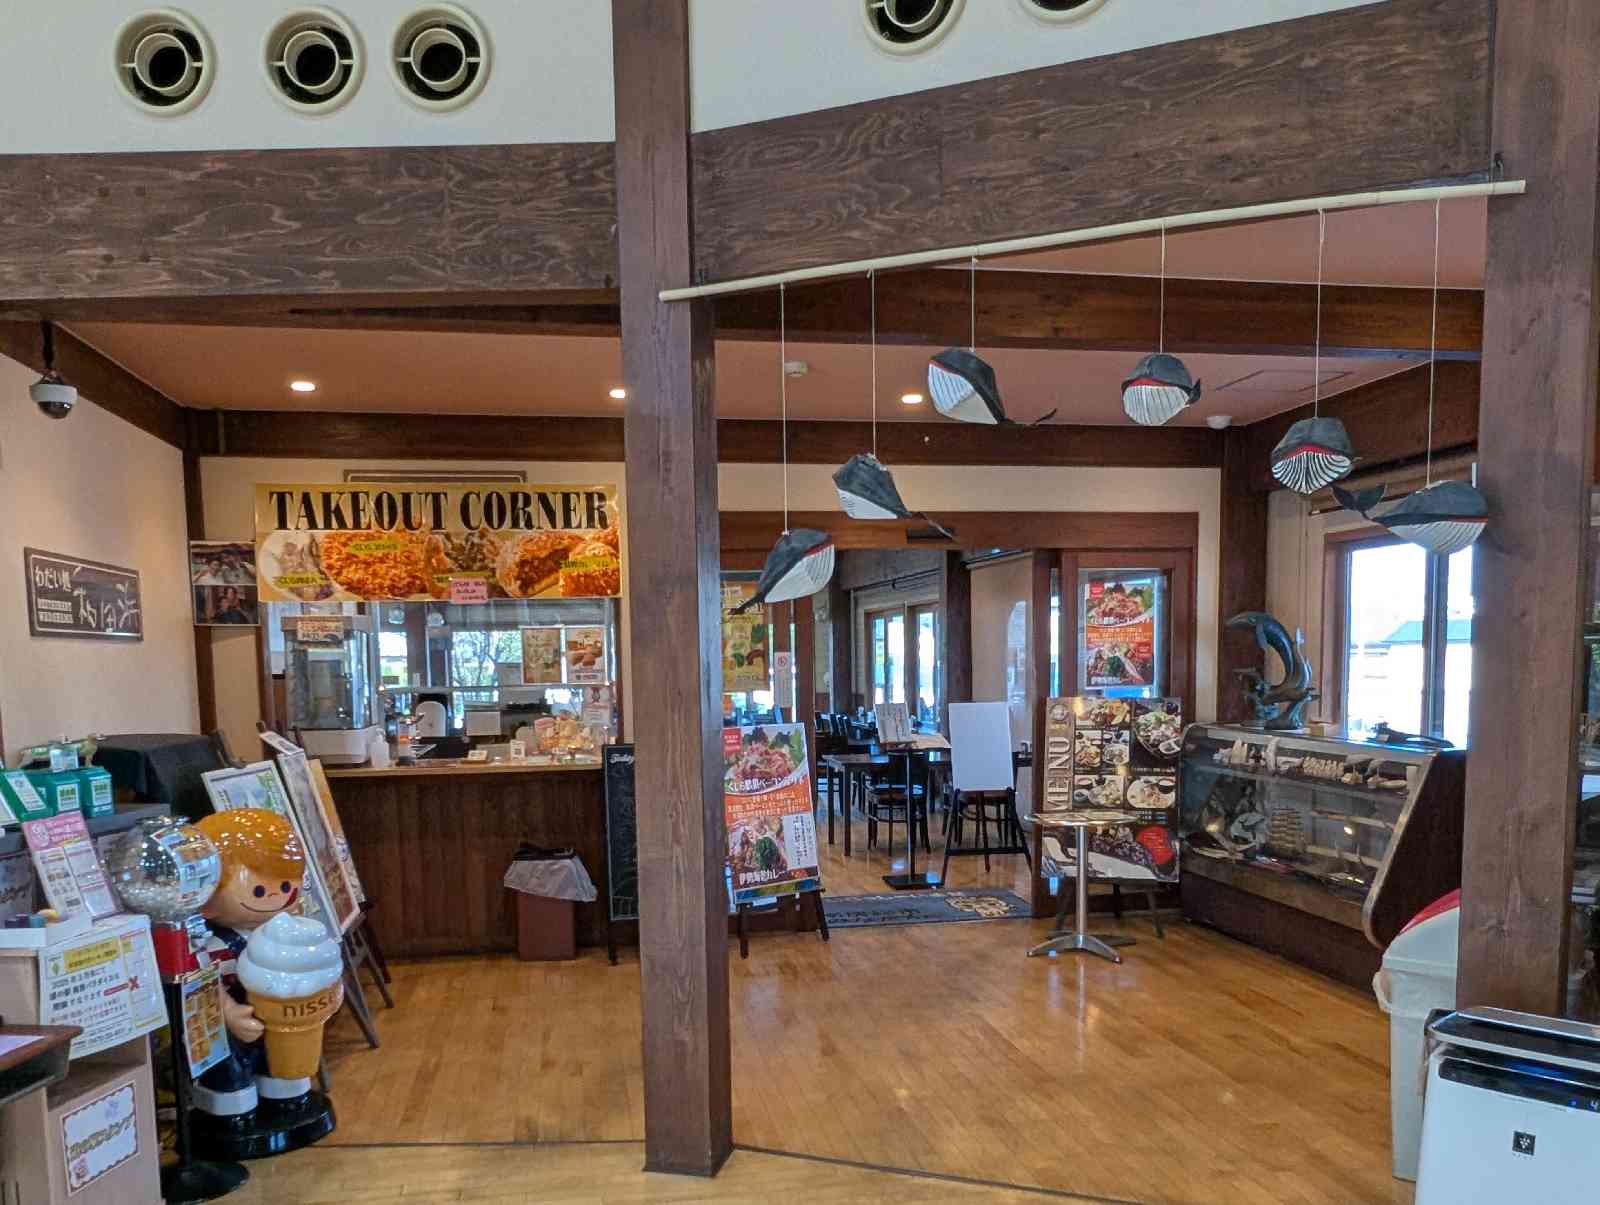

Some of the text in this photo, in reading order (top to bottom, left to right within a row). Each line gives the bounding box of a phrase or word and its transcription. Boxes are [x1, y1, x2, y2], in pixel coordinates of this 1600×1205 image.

[269, 490, 609, 531] TAKEOUT CORNER
[1047, 736, 1071, 811] MENU
